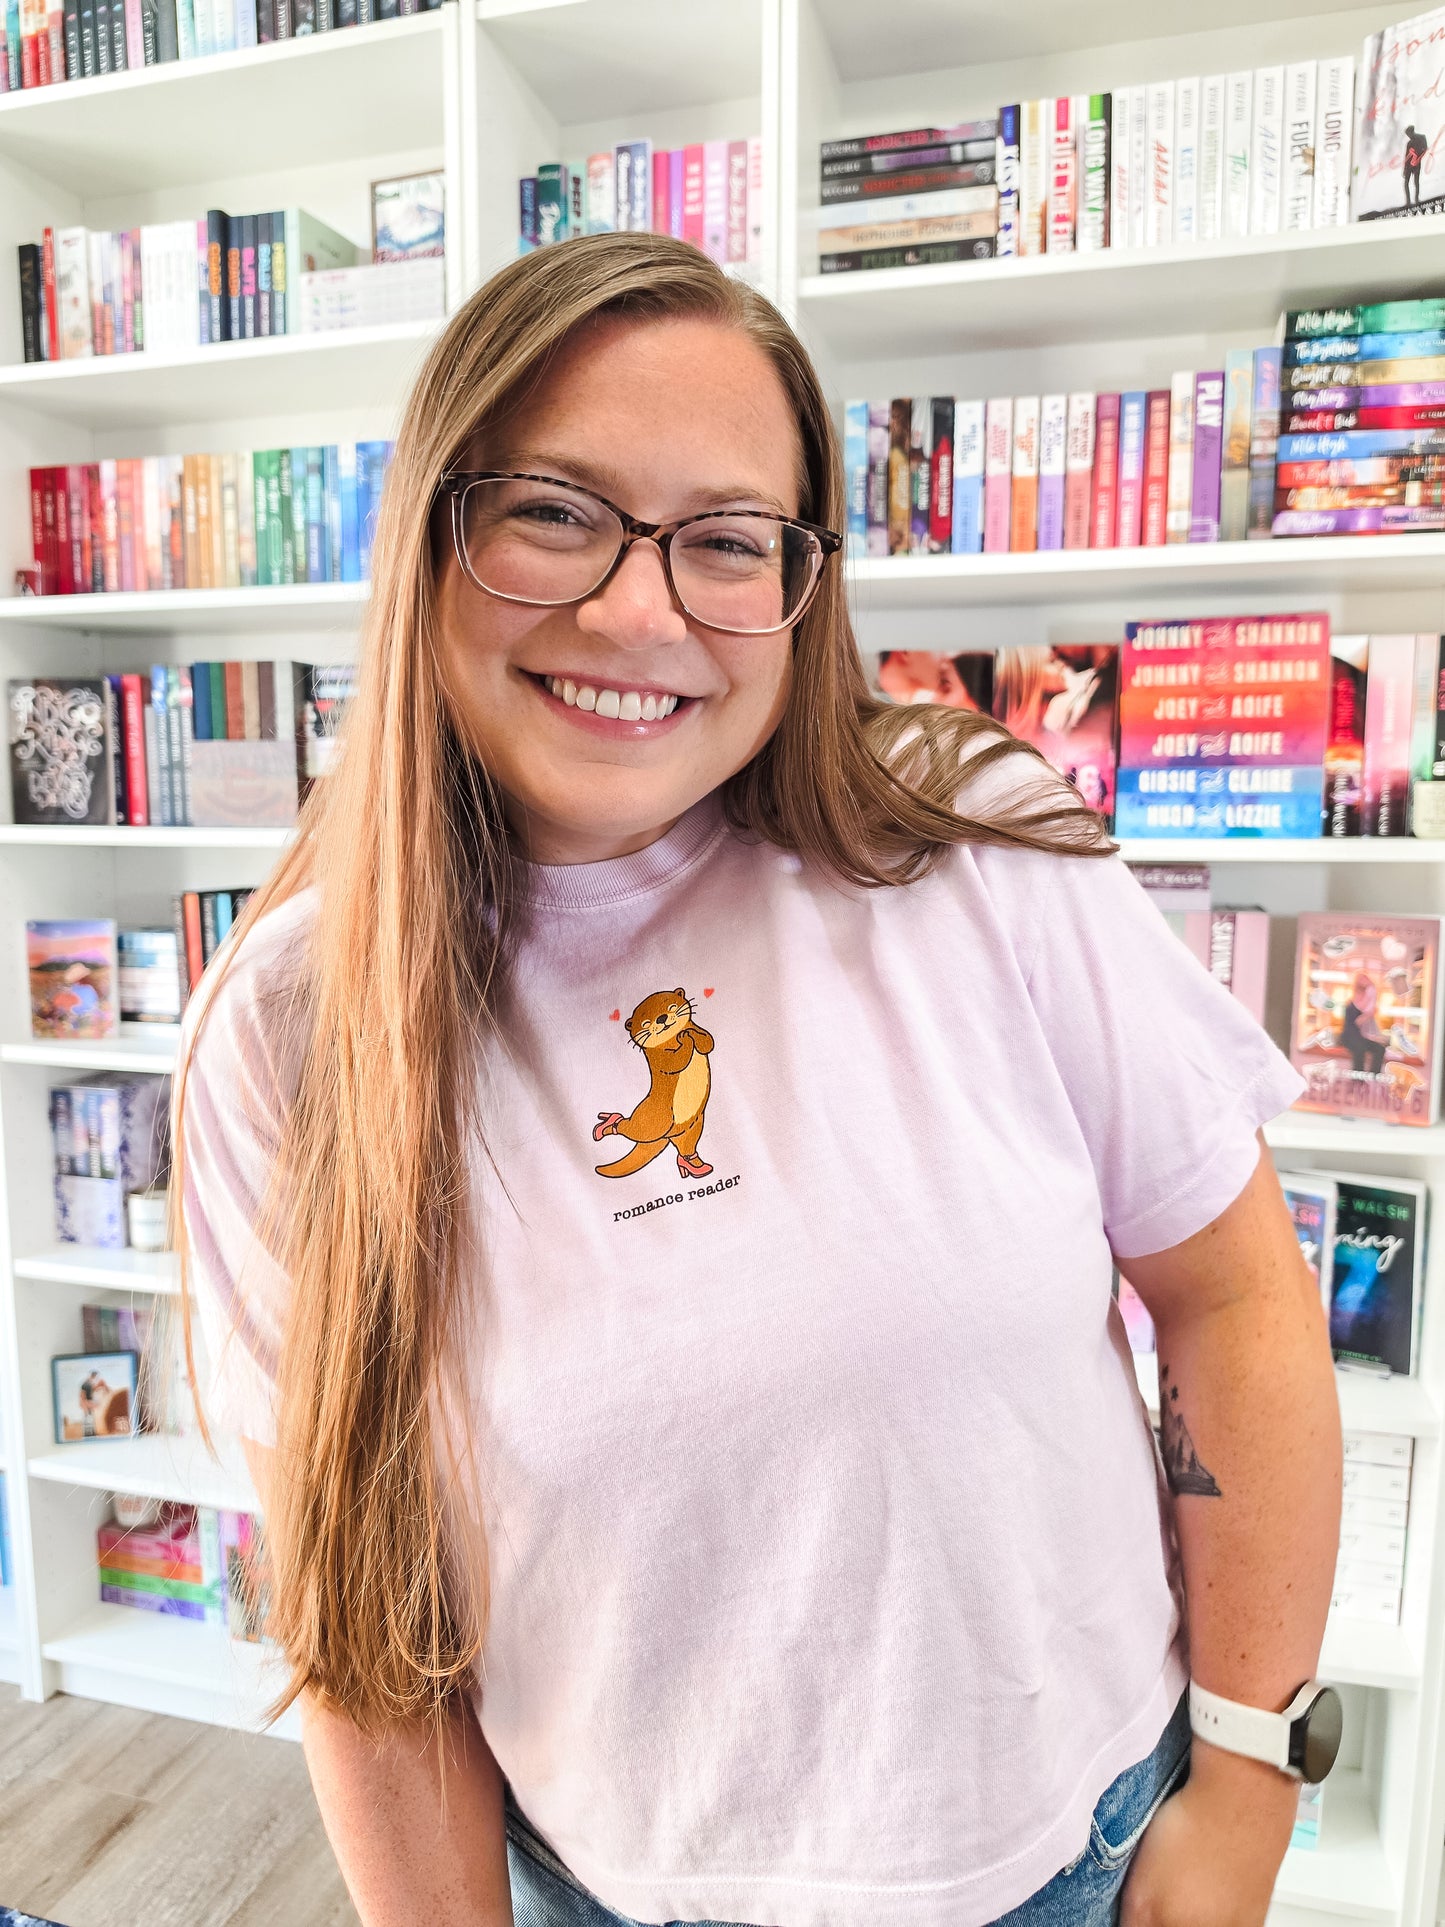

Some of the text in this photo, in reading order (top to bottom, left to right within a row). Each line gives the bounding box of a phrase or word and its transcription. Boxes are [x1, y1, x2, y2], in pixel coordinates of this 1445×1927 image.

[1084, 120, 1106, 168] LONG
[1324, 111, 1343, 153] LONG
[1085, 168, 1106, 209] WAY
[1196, 380, 1223, 428] PLAY
[1290, 436, 1317, 457] Mile
[1317, 435, 1348, 458] High
[1132, 625, 1202, 651] JOHNNY
[1236, 621, 1322, 647] SHANNON
[1131, 663, 1201, 688] JOHNNY
[1233, 659, 1320, 684] SHANNON
[1153, 696, 1200, 720] JOEY
[1230, 694, 1284, 719] AOIFE
[1152, 733, 1199, 758] JOEY
[1228, 731, 1284, 756] AOIFE
[1164, 873, 1203, 885] WALSH
[613, 1174, 742, 1222] romance reader
[1352, 1198, 1411, 1221] WALSH
